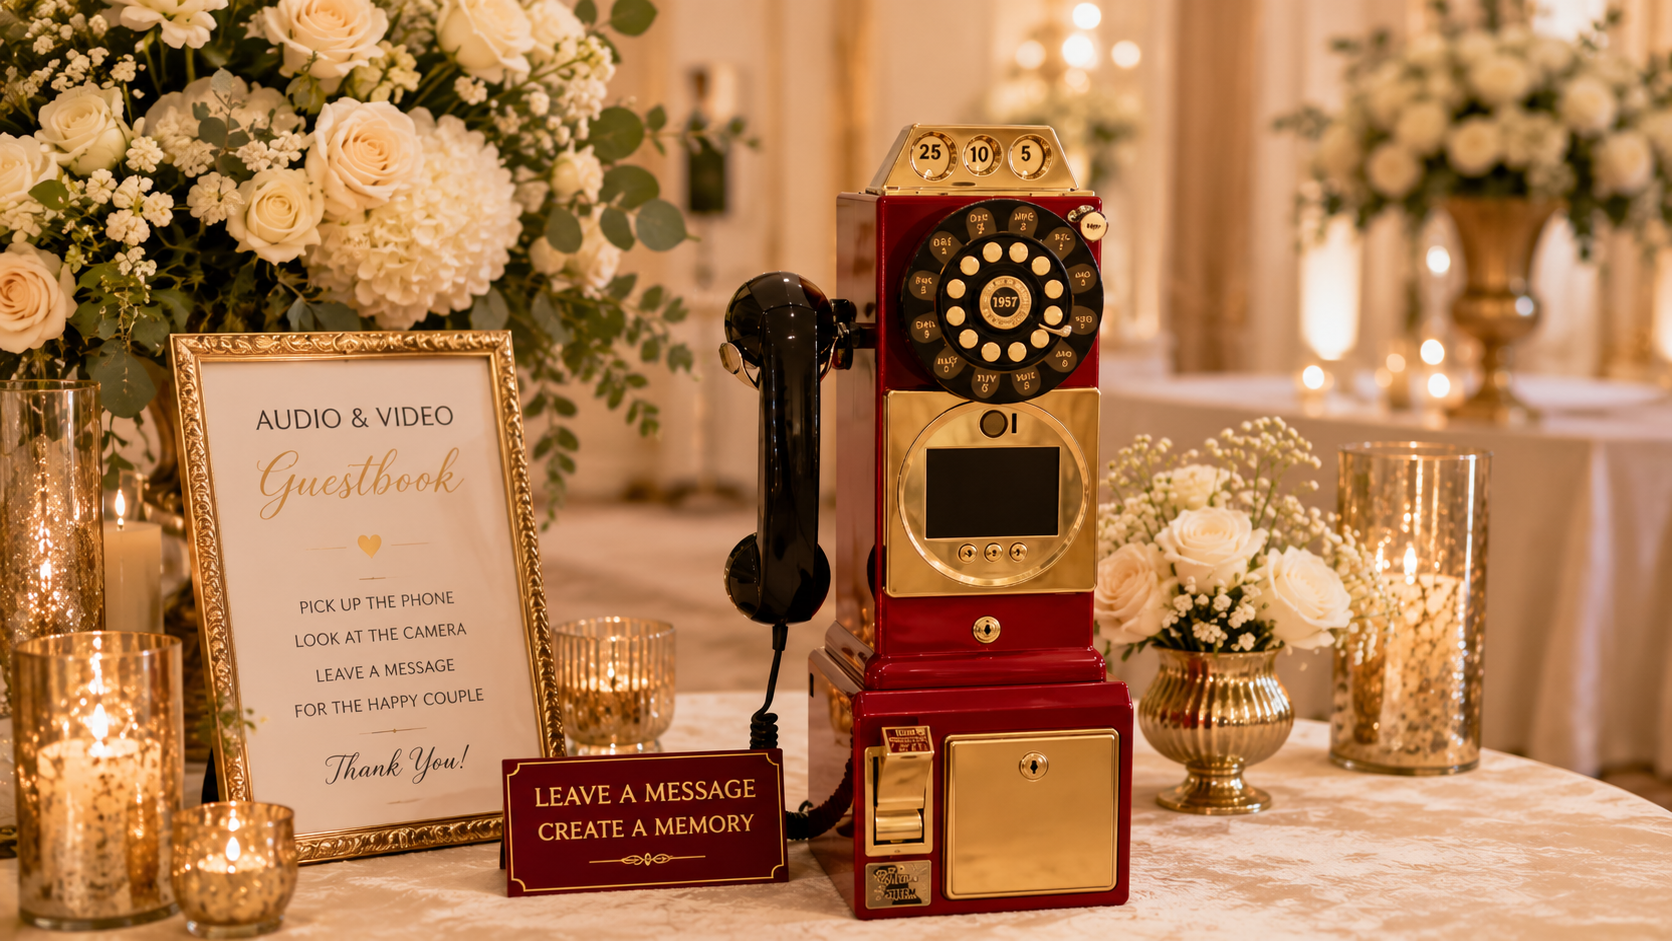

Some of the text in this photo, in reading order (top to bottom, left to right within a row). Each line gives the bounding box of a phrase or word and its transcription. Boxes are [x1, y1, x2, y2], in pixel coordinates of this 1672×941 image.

[919, 144, 1031, 162] 25 10 5
[992, 296, 1018, 308] 1957
[256, 405, 454, 430] AUDIO & VIDEO
[256, 447, 465, 520] Guestbook
[299, 591, 455, 614] PICK UP THE PHONE
[294, 622, 467, 648] LOOK AT THE CAMERA
[315, 658, 455, 682] LEAVE A MESSAGE
[294, 688, 485, 718] FOR THE HAPPY COUPLE
[325, 744, 470, 785] Thank You!
[535, 779, 757, 808] LEAVE A MESSAGE
[538, 814, 755, 841] CREATE A MEMORY
